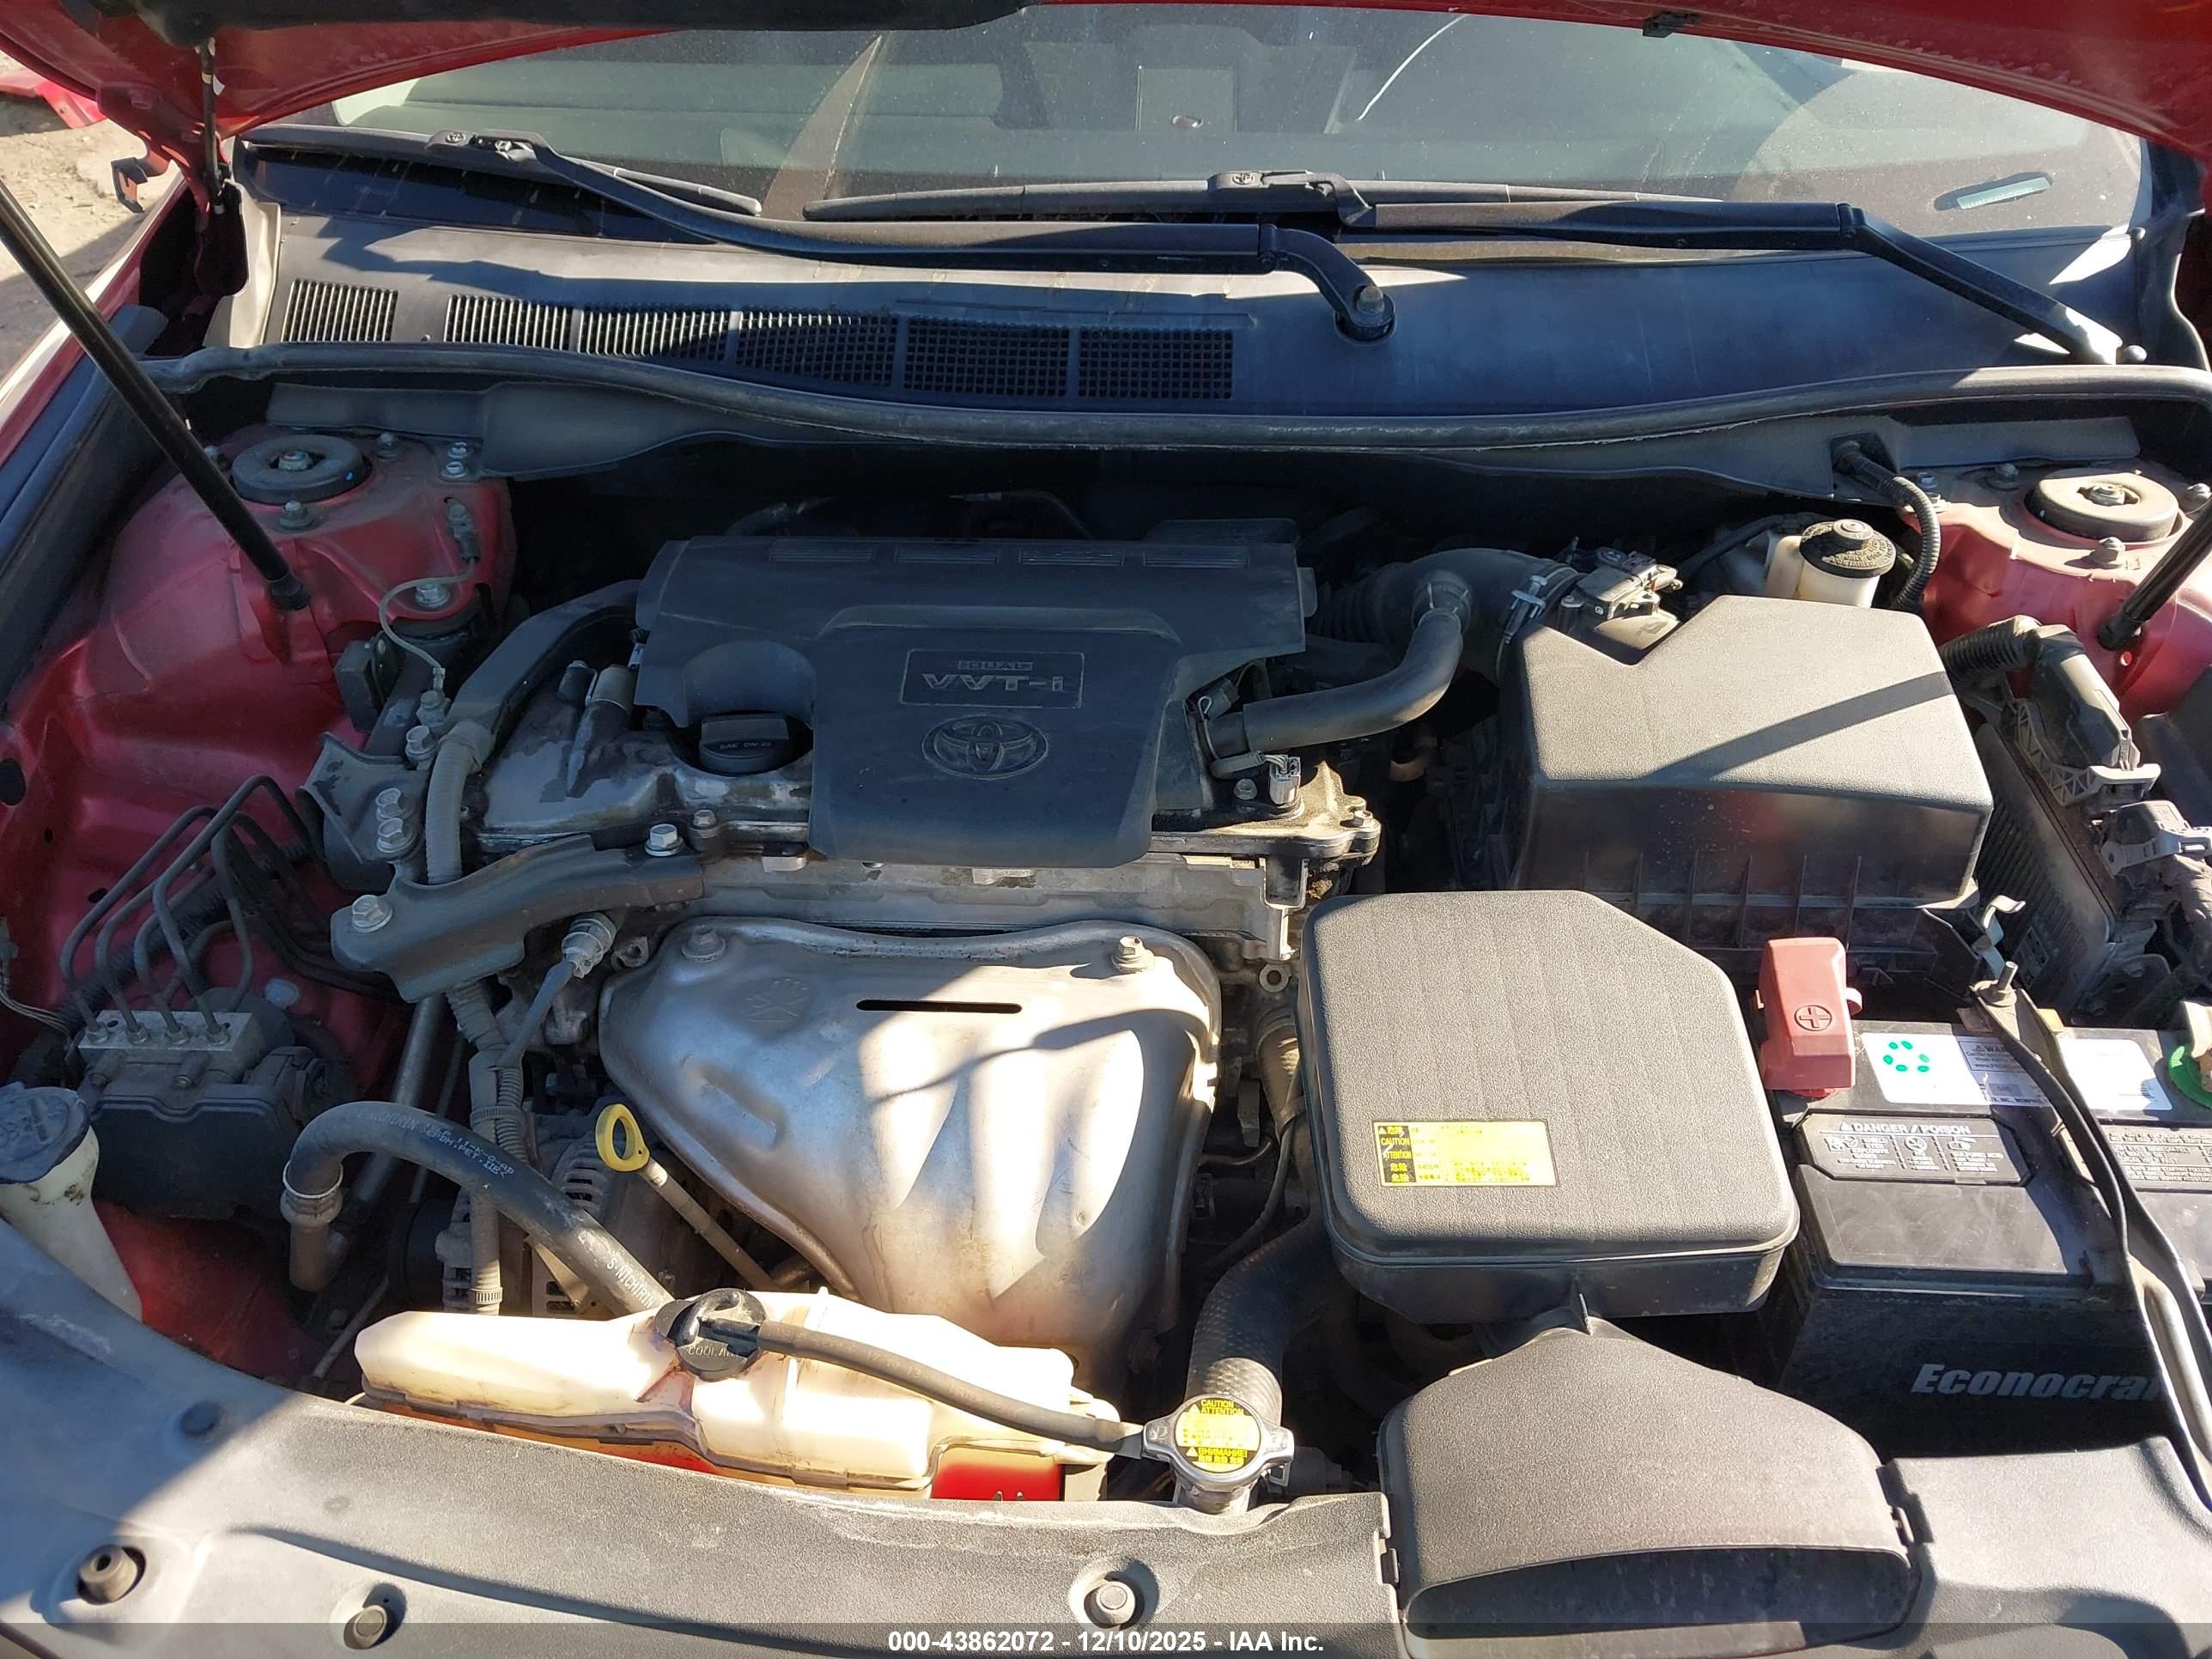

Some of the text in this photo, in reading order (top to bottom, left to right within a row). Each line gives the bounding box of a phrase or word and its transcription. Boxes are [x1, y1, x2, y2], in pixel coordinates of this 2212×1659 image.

[1854, 1123, 1909, 1133] DANGER
[1923, 1125, 1971, 1134] POISON
[1381, 1137, 1410, 1146] CAUTION
[688, 1345, 738, 1358] COOLA
[1200, 1400, 1234, 1408] CAUTION
[1198, 1448, 1248, 1457] ВНИМАНИЕ!
